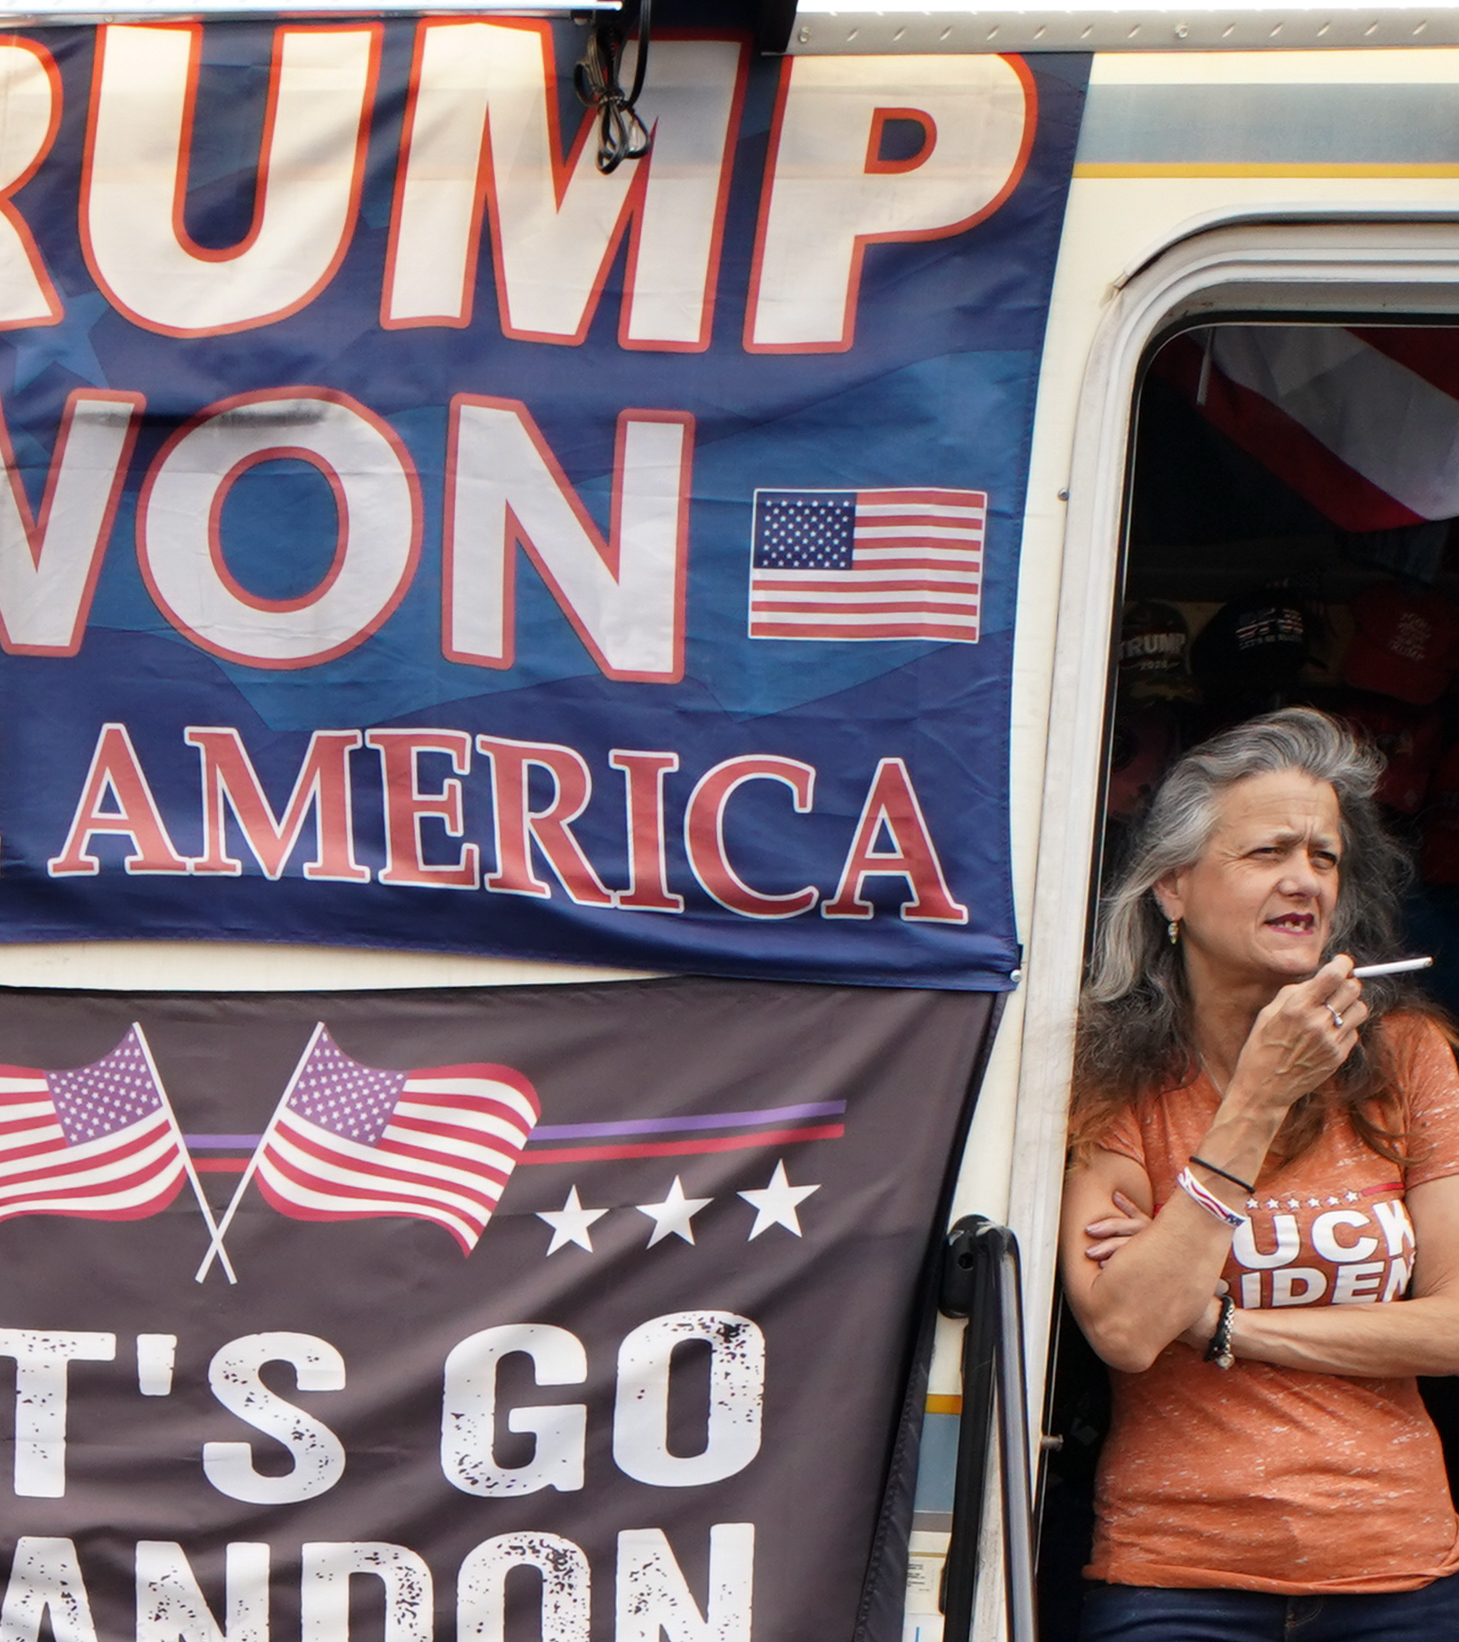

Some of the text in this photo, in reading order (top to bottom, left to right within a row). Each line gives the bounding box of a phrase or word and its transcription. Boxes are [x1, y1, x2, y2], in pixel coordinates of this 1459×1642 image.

[49, 722, 969, 924] AMERICA
[1232, 1200, 1416, 1269] UCK
[1242, 1251, 1416, 1309] IDEN
[440, 1310, 765, 1498] GO
